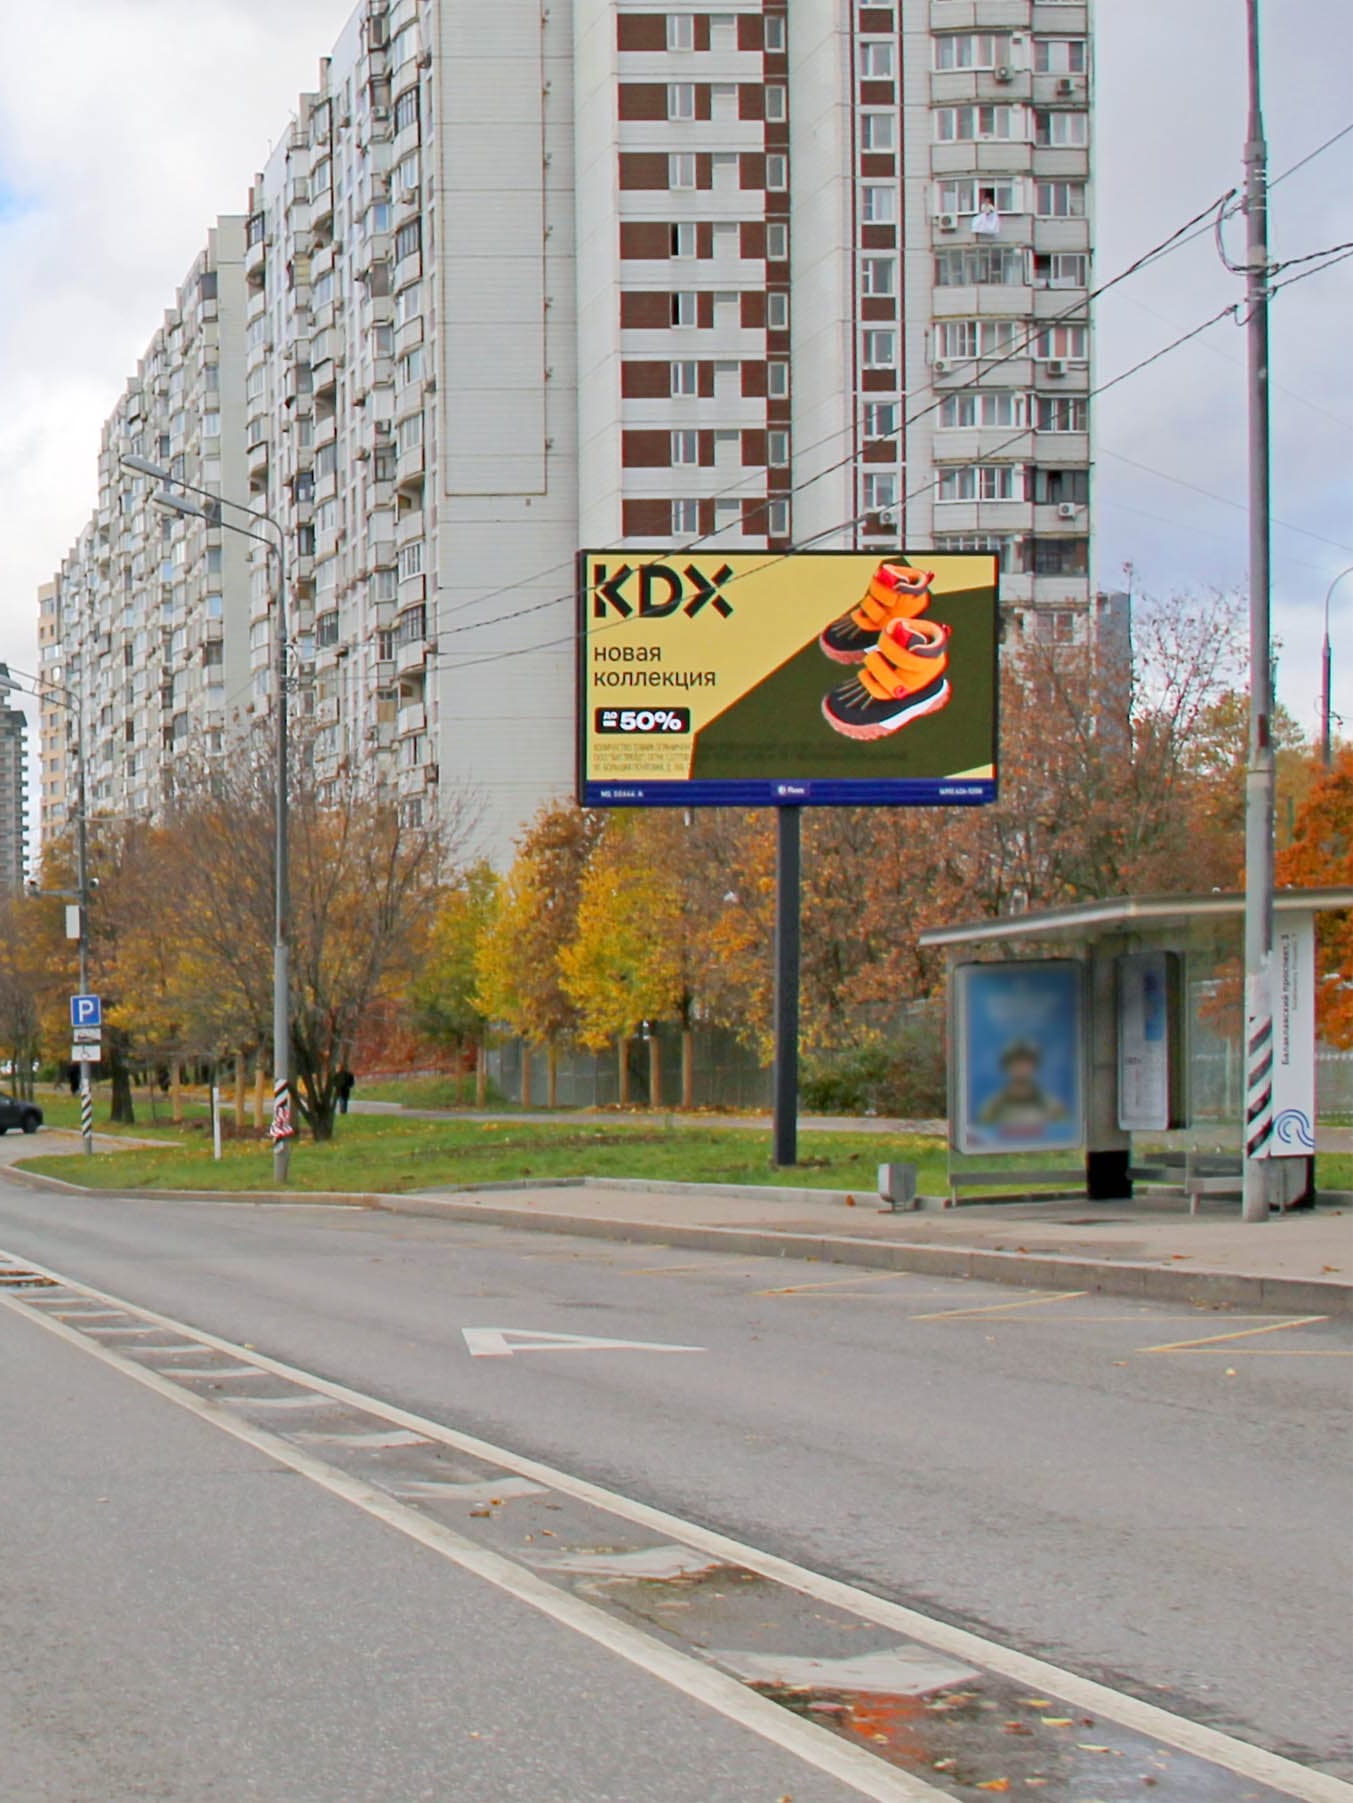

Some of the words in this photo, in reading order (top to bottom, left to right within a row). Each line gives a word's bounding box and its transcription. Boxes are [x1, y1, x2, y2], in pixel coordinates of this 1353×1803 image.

[594, 564, 733, 618] KDX
[594, 646, 661, 661] новая
[594, 671, 715, 690] коллекция
[79, 1000, 93, 1022] P
